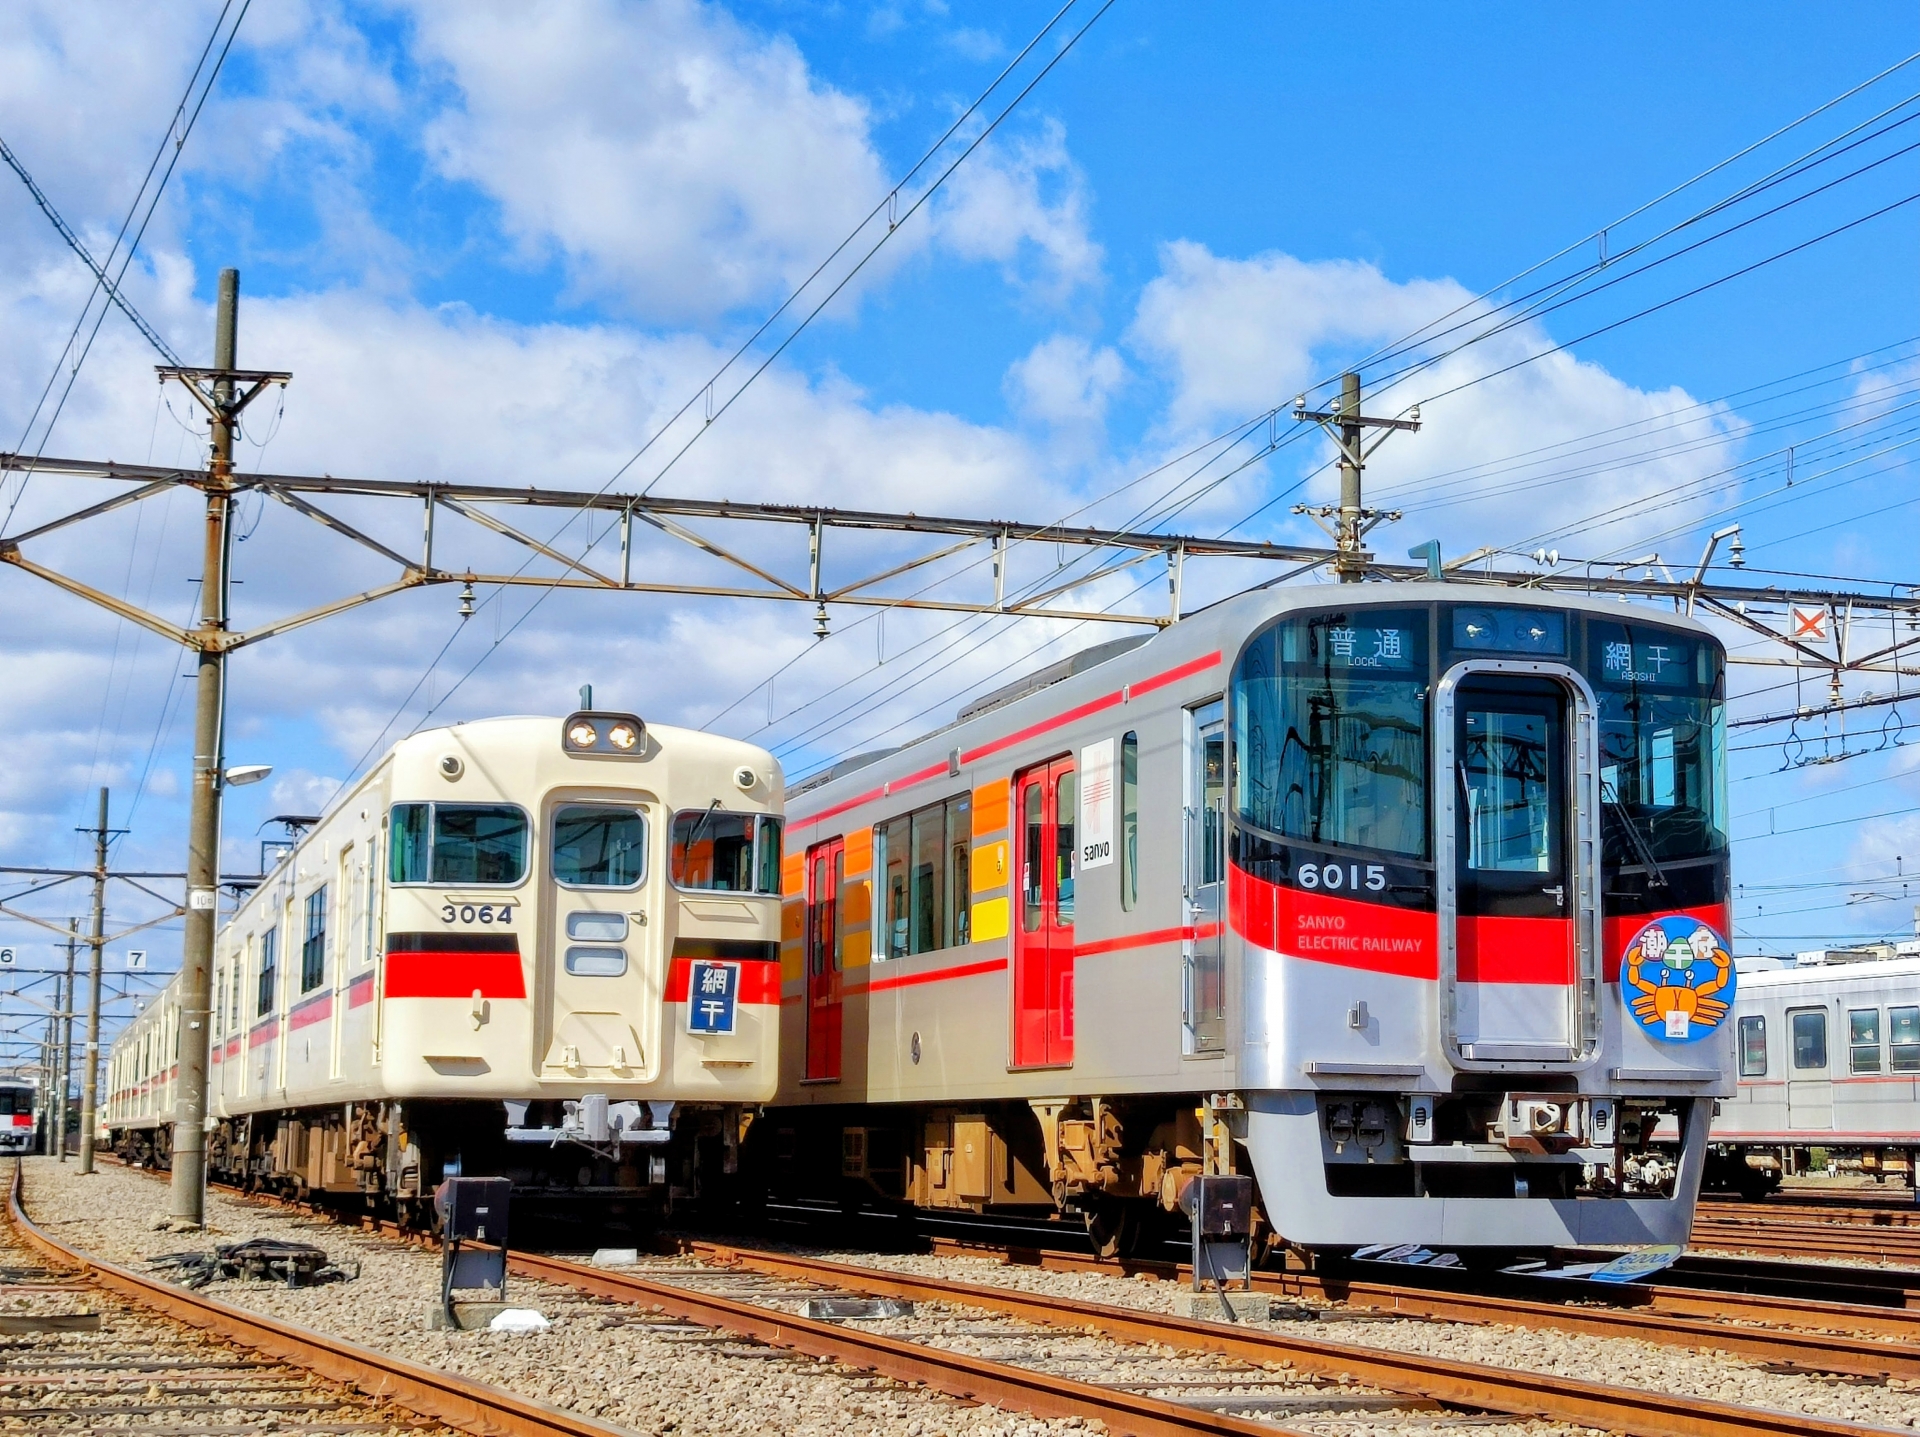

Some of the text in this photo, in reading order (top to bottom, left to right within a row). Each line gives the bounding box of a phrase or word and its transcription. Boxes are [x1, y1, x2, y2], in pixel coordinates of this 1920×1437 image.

[1329, 627, 1401, 658] 普通
[1347, 656, 1381, 667] LOCAL
[1605, 642, 1671, 673] 網干
[1621, 671, 1656, 682] ABOSHI
[1084, 841, 1110, 862] sanyo
[1298, 863, 1386, 891] 6015
[441, 905, 512, 924] 3064
[1298, 915, 1345, 930] SANYO
[1298, 935, 1422, 952] ELECTRIC RAILWAY
[0, 949, 13, 963] 6
[131, 952, 143, 966] 7
[701, 968, 728, 1027] 網干
